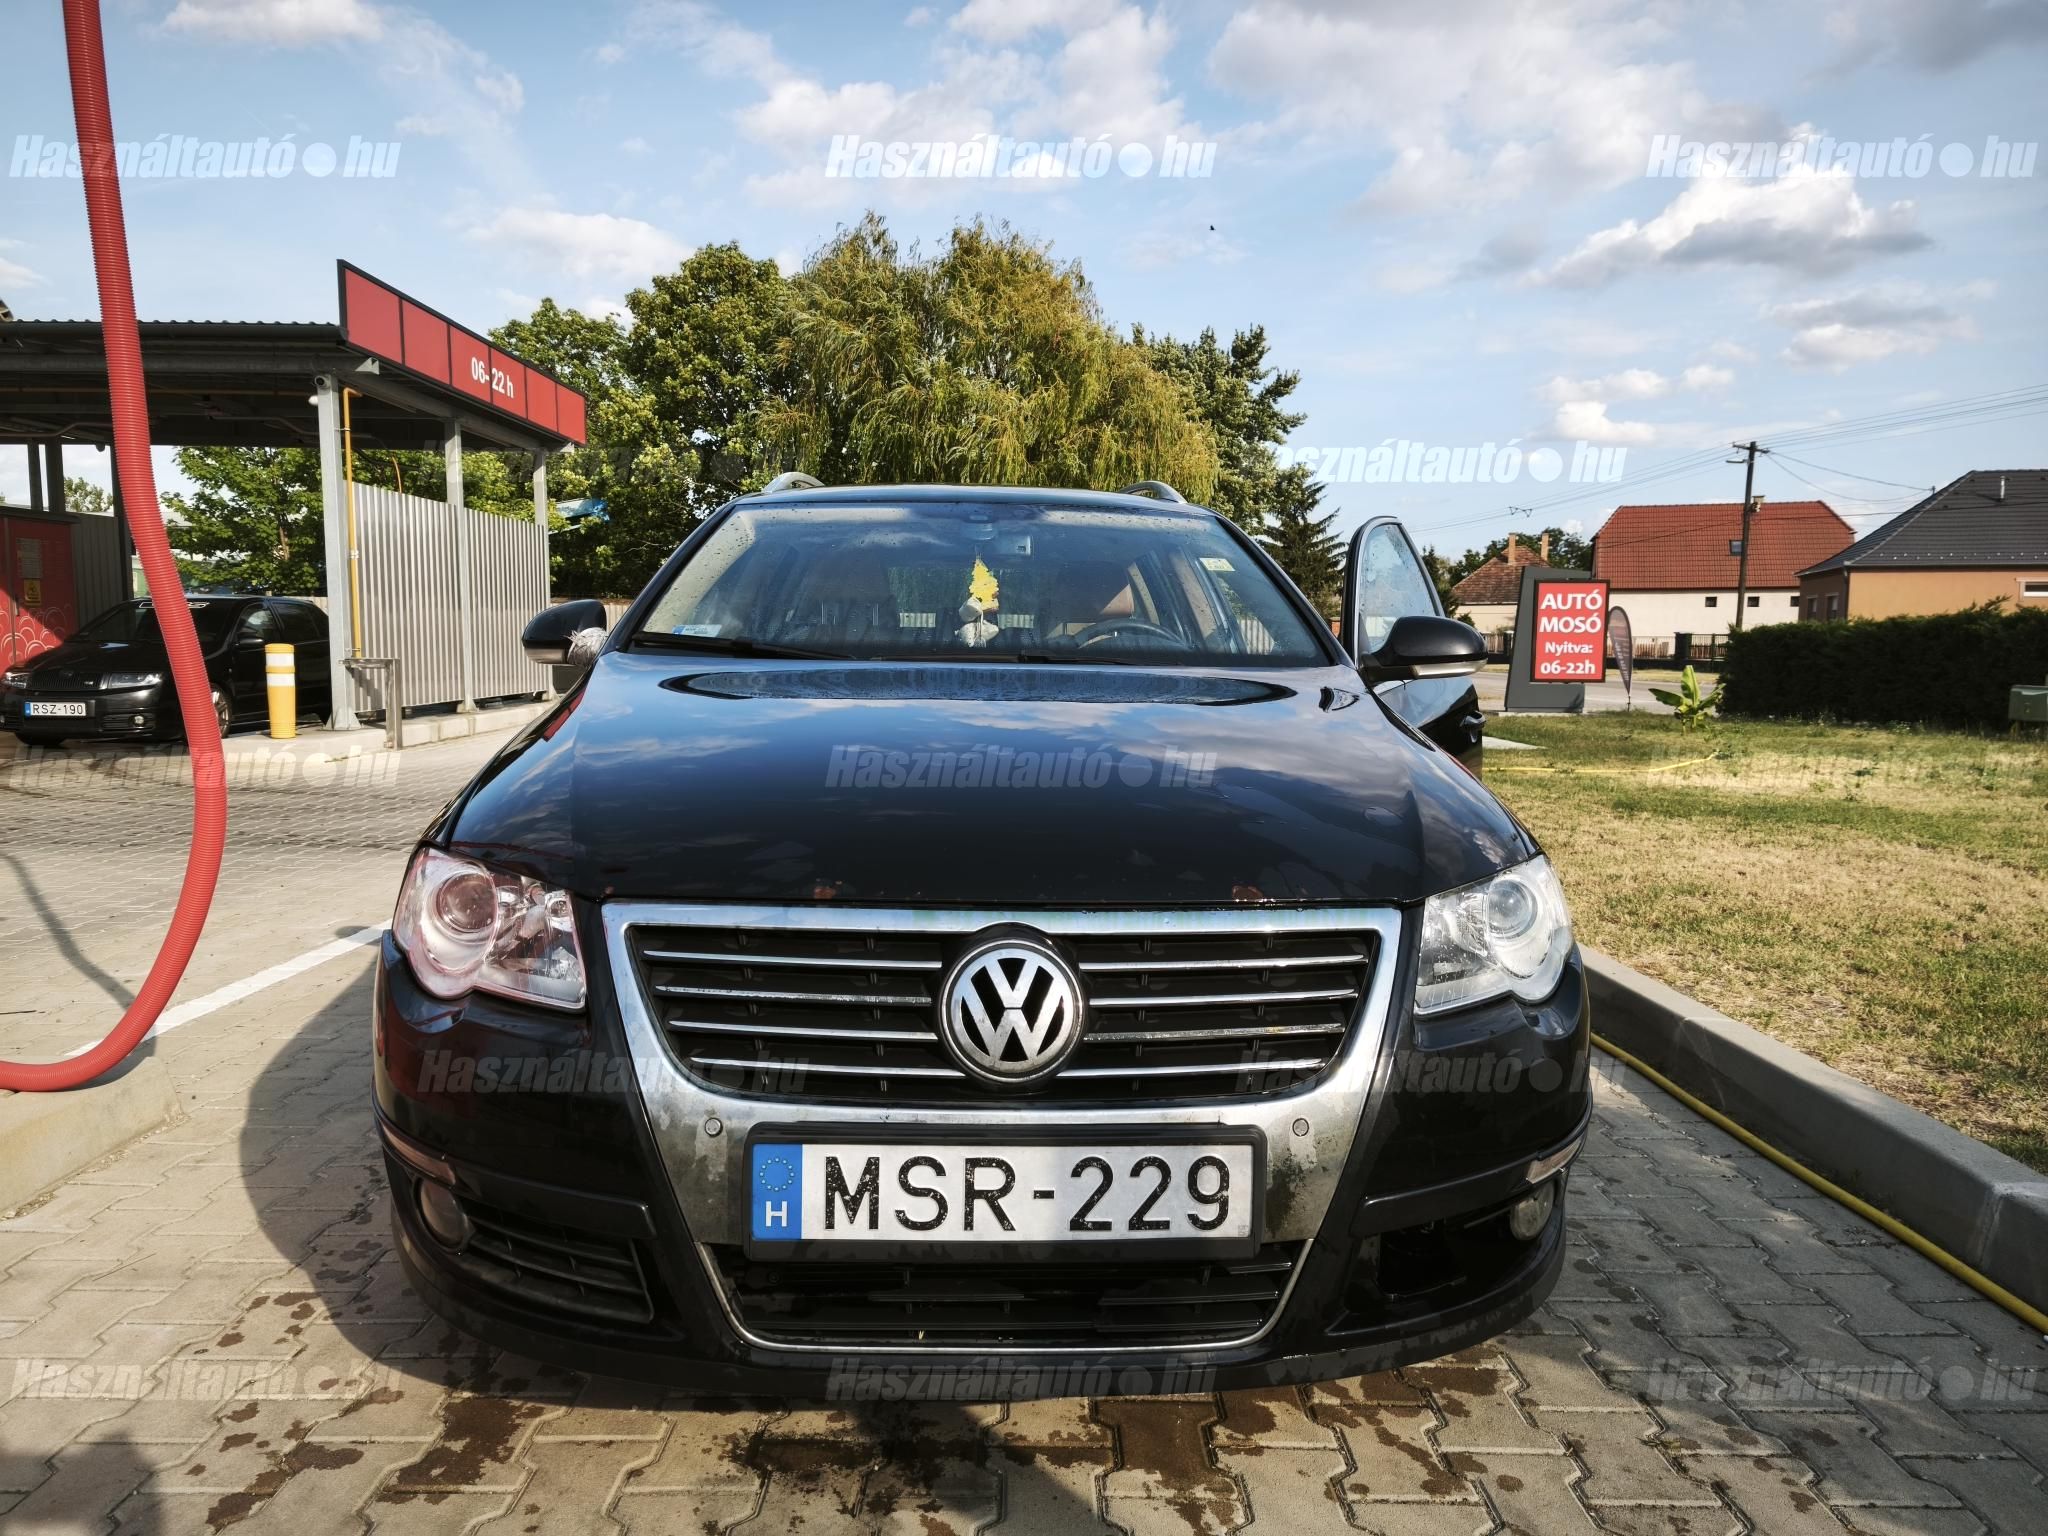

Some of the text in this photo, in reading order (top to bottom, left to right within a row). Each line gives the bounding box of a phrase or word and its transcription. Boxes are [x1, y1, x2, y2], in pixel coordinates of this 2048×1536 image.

[1540, 589, 1603, 610] AUTÓ
[1539, 613, 1602, 634] MOSÓ
[1545, 641, 1593, 656] Nyitva:
[1540, 660, 1596, 674] 06-22h
[32, 703, 84, 715] RSZ-190
[765, 1155, 1230, 1231] H MSR-229
